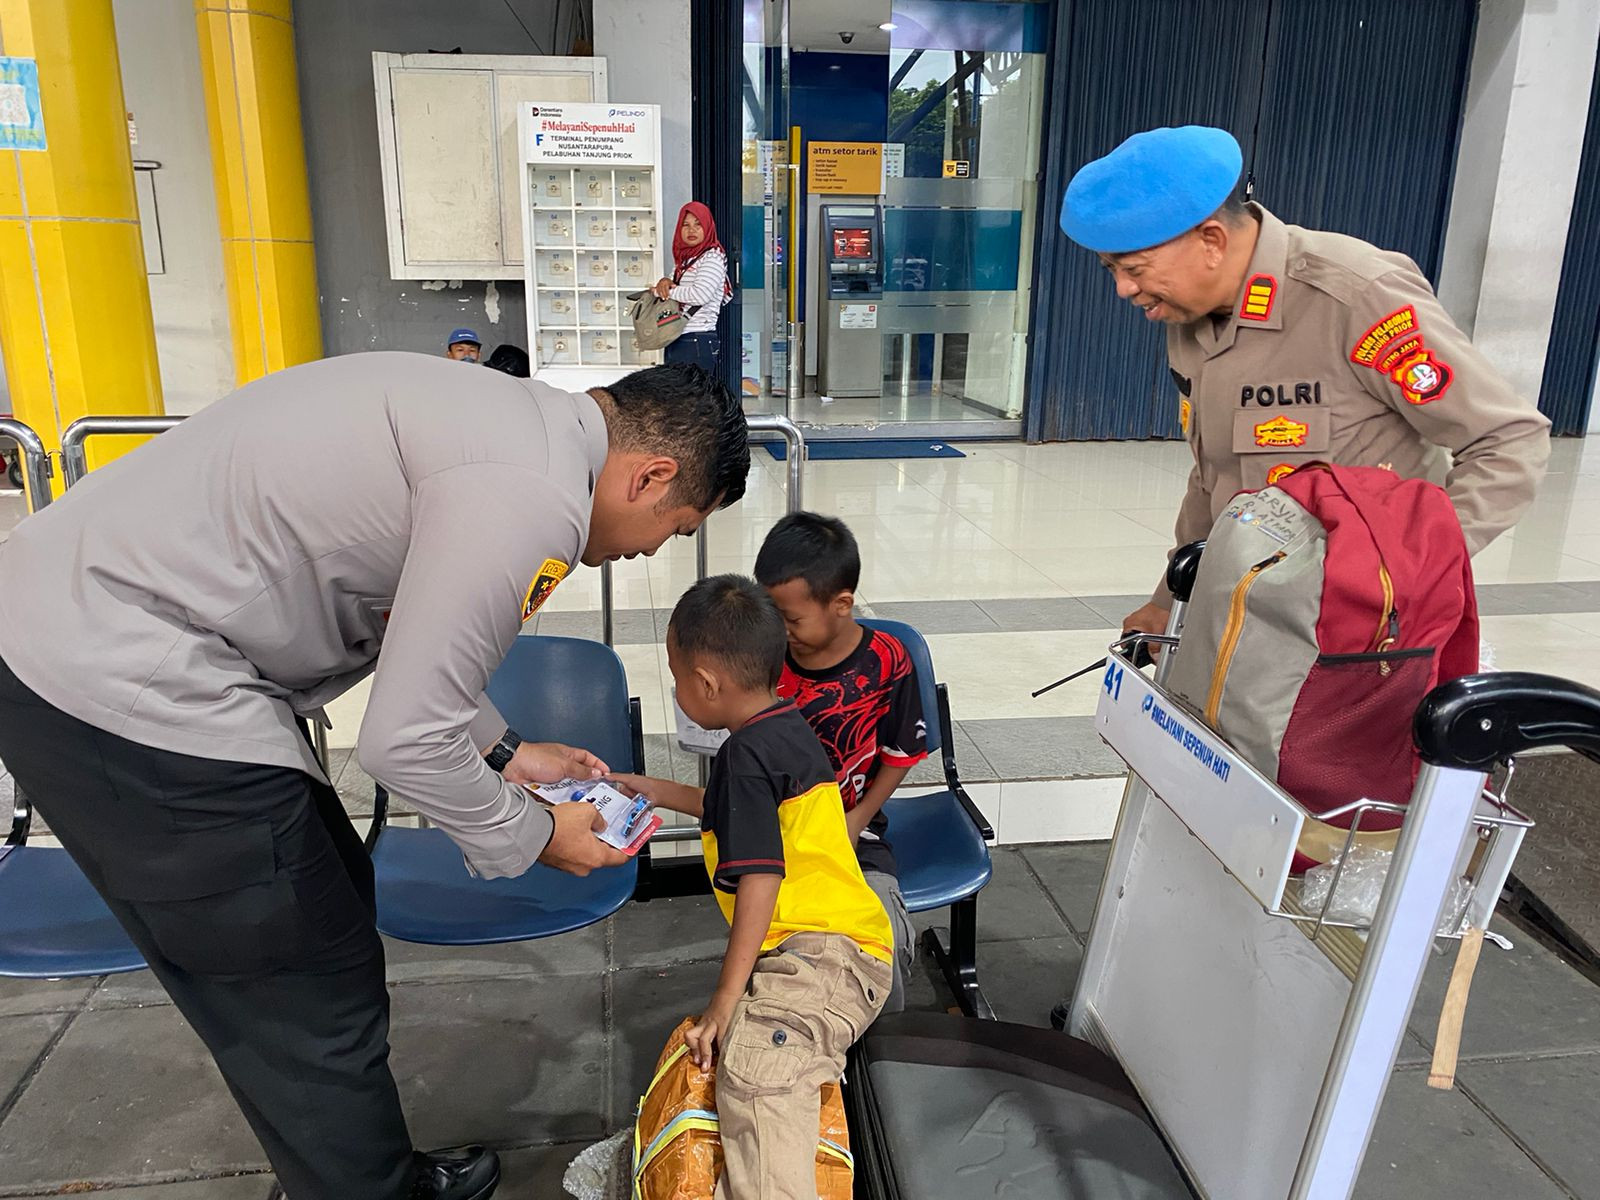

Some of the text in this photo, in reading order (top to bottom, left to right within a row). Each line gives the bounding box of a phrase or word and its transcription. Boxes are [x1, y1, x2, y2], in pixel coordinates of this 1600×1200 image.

[541, 120, 635, 134] #MelayaniSepenuhHati
[535, 133, 544, 146] F
[550, 135, 583, 143] TERMINAL
[558, 143, 613, 151] NUSANTARAPURA
[813, 147, 831, 155] atm
[833, 147, 855, 156] setor
[857, 147, 878, 156] tarik
[542, 150, 581, 158] PELABUHAN
[1388, 320, 1414, 338] PRIOK
[1400, 339, 1419, 354] JAYA
[1241, 381, 1321, 407] POLRI
[1104, 662, 1124, 700] 41
[1182, 729, 1215, 769] SEPENUH
[1211, 754, 1231, 783] HATI
[543, 779, 577, 792] RACING
